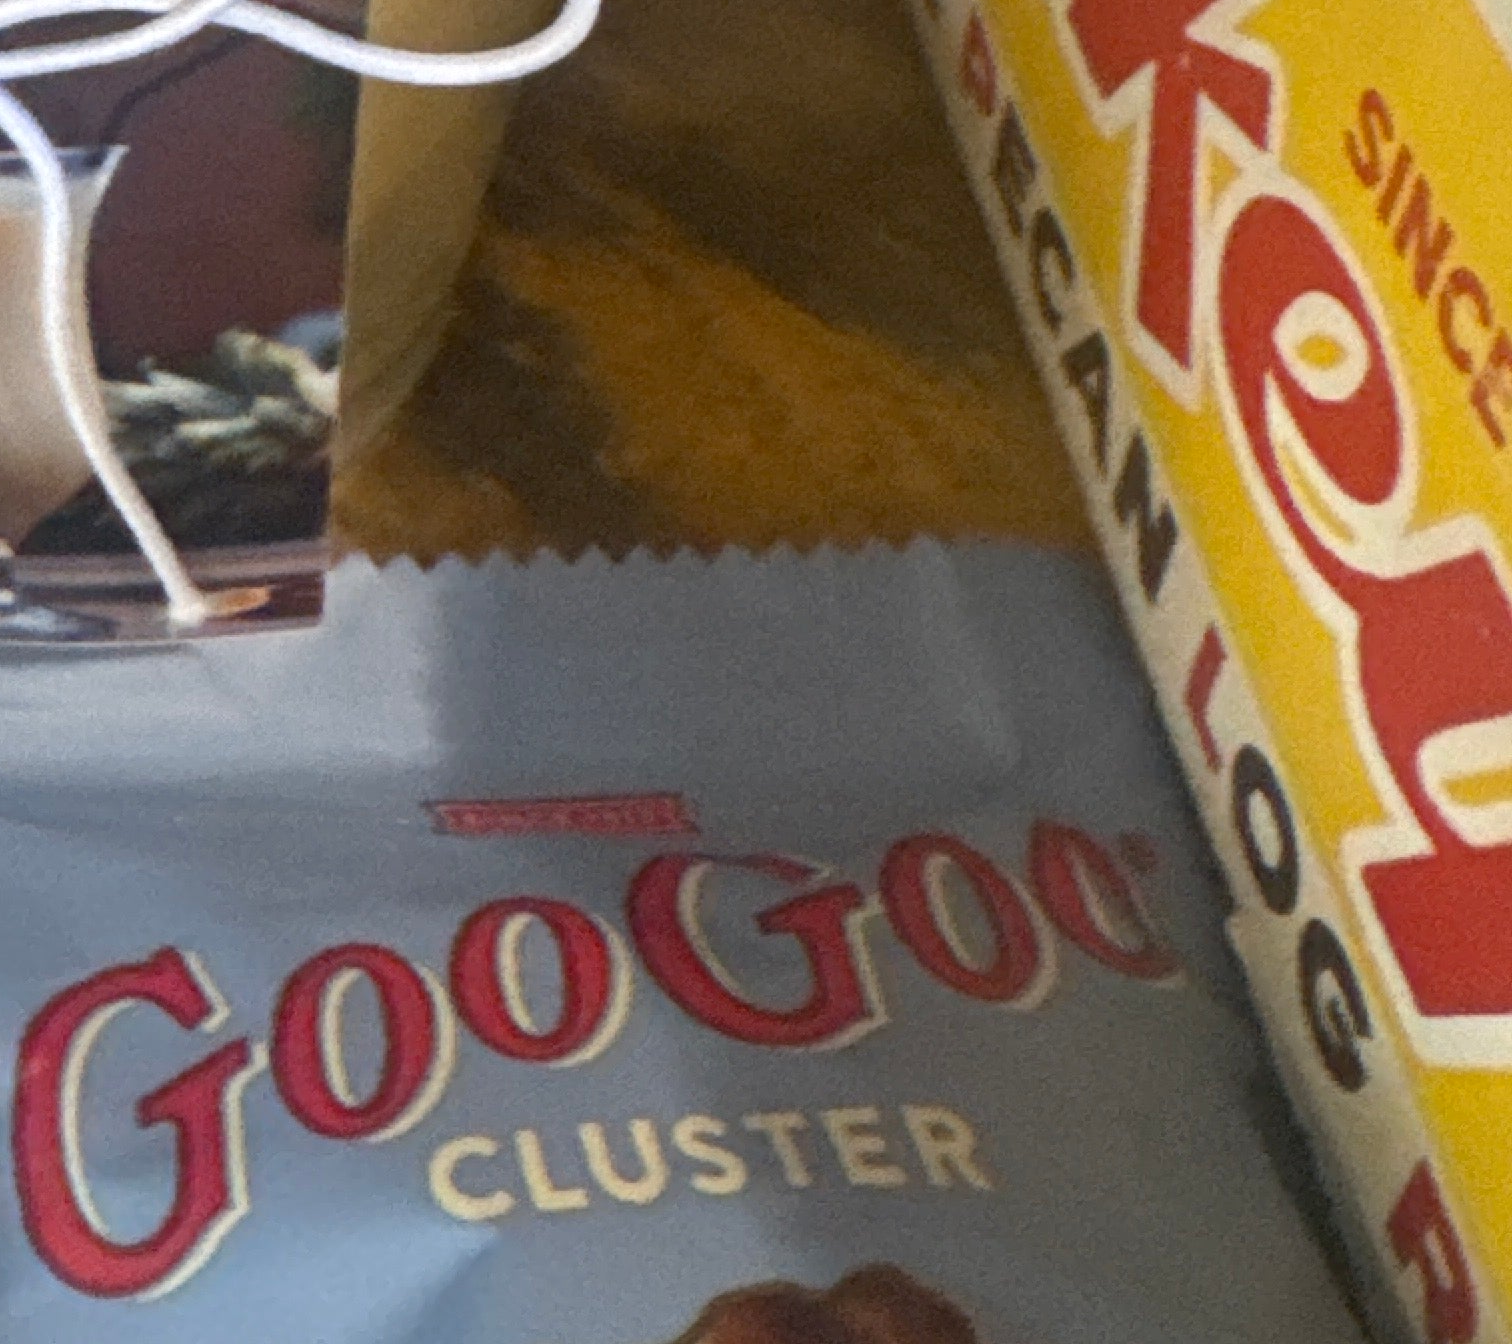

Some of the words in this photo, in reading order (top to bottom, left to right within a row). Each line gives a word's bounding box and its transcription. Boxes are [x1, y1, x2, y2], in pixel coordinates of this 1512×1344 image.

[960, 5, 1179, 605] PECAN
[1183, 620, 1376, 1093] LOG
[428, 1102, 996, 1223] CLUSTER
